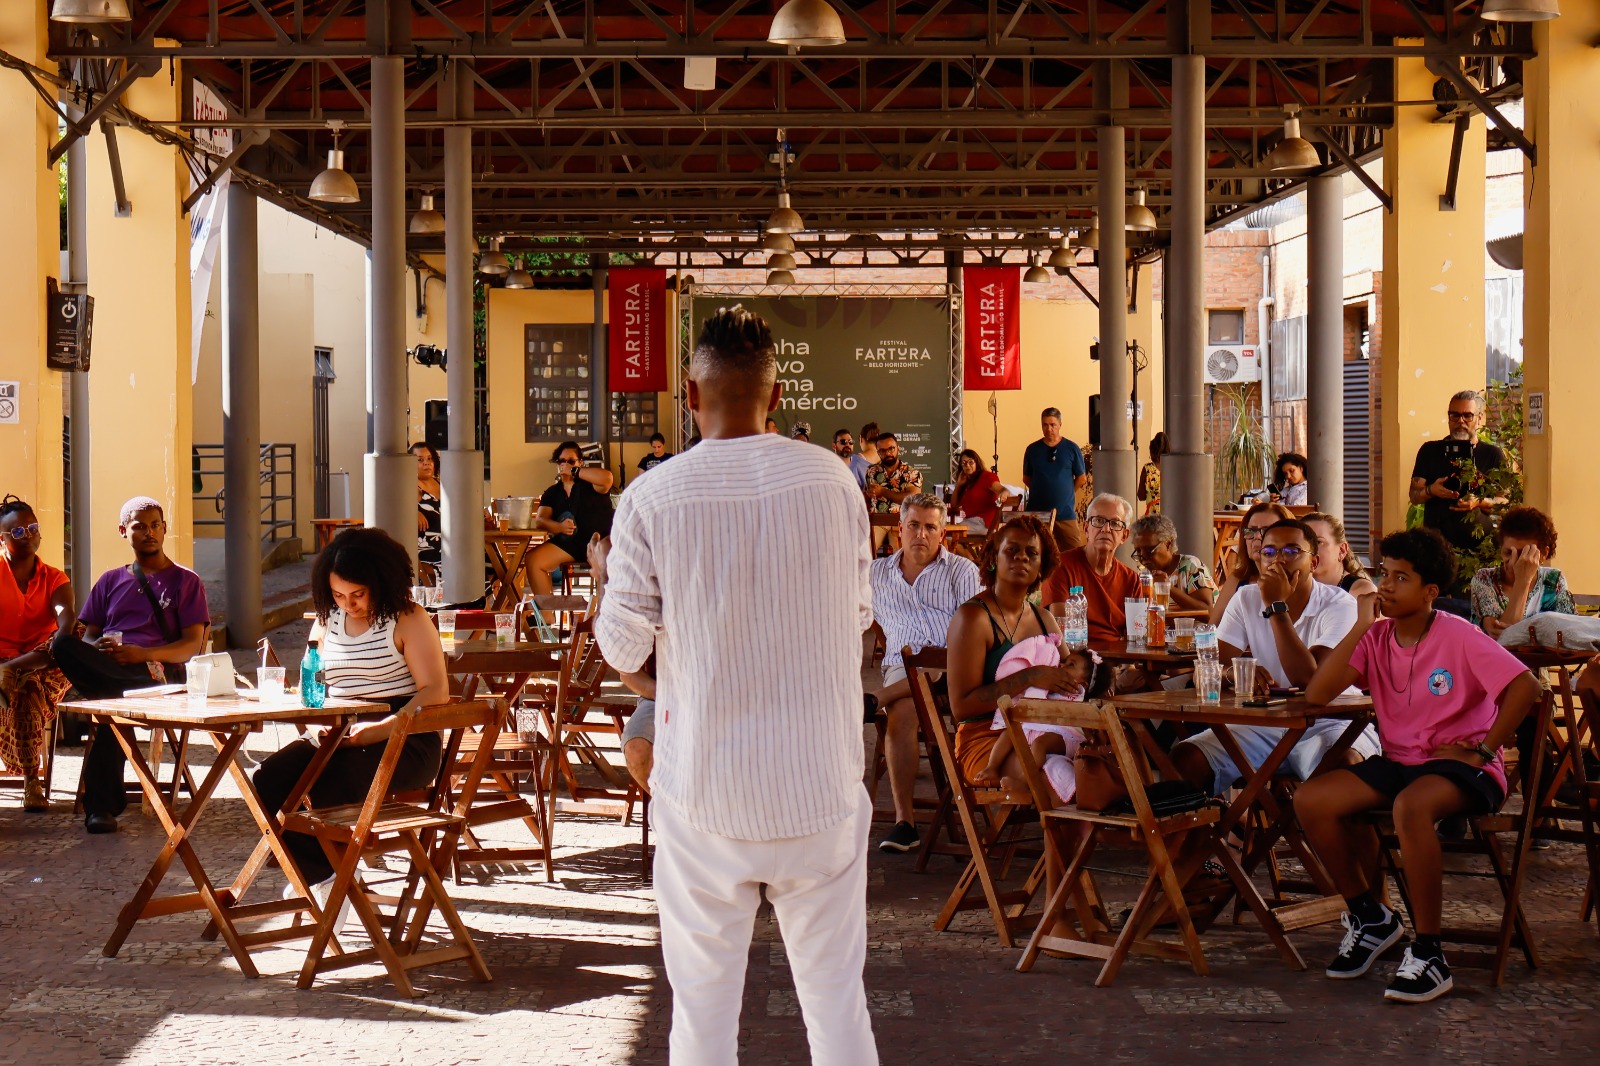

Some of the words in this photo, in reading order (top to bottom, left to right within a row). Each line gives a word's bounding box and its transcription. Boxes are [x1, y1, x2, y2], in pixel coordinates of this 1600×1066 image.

[644, 312, 650, 321] DO
[999, 312, 1005, 321] DO
[625, 283, 640, 378] FARTURA
[980, 283, 995, 377] FARTURA
[855, 348, 931, 361] FARTURA
